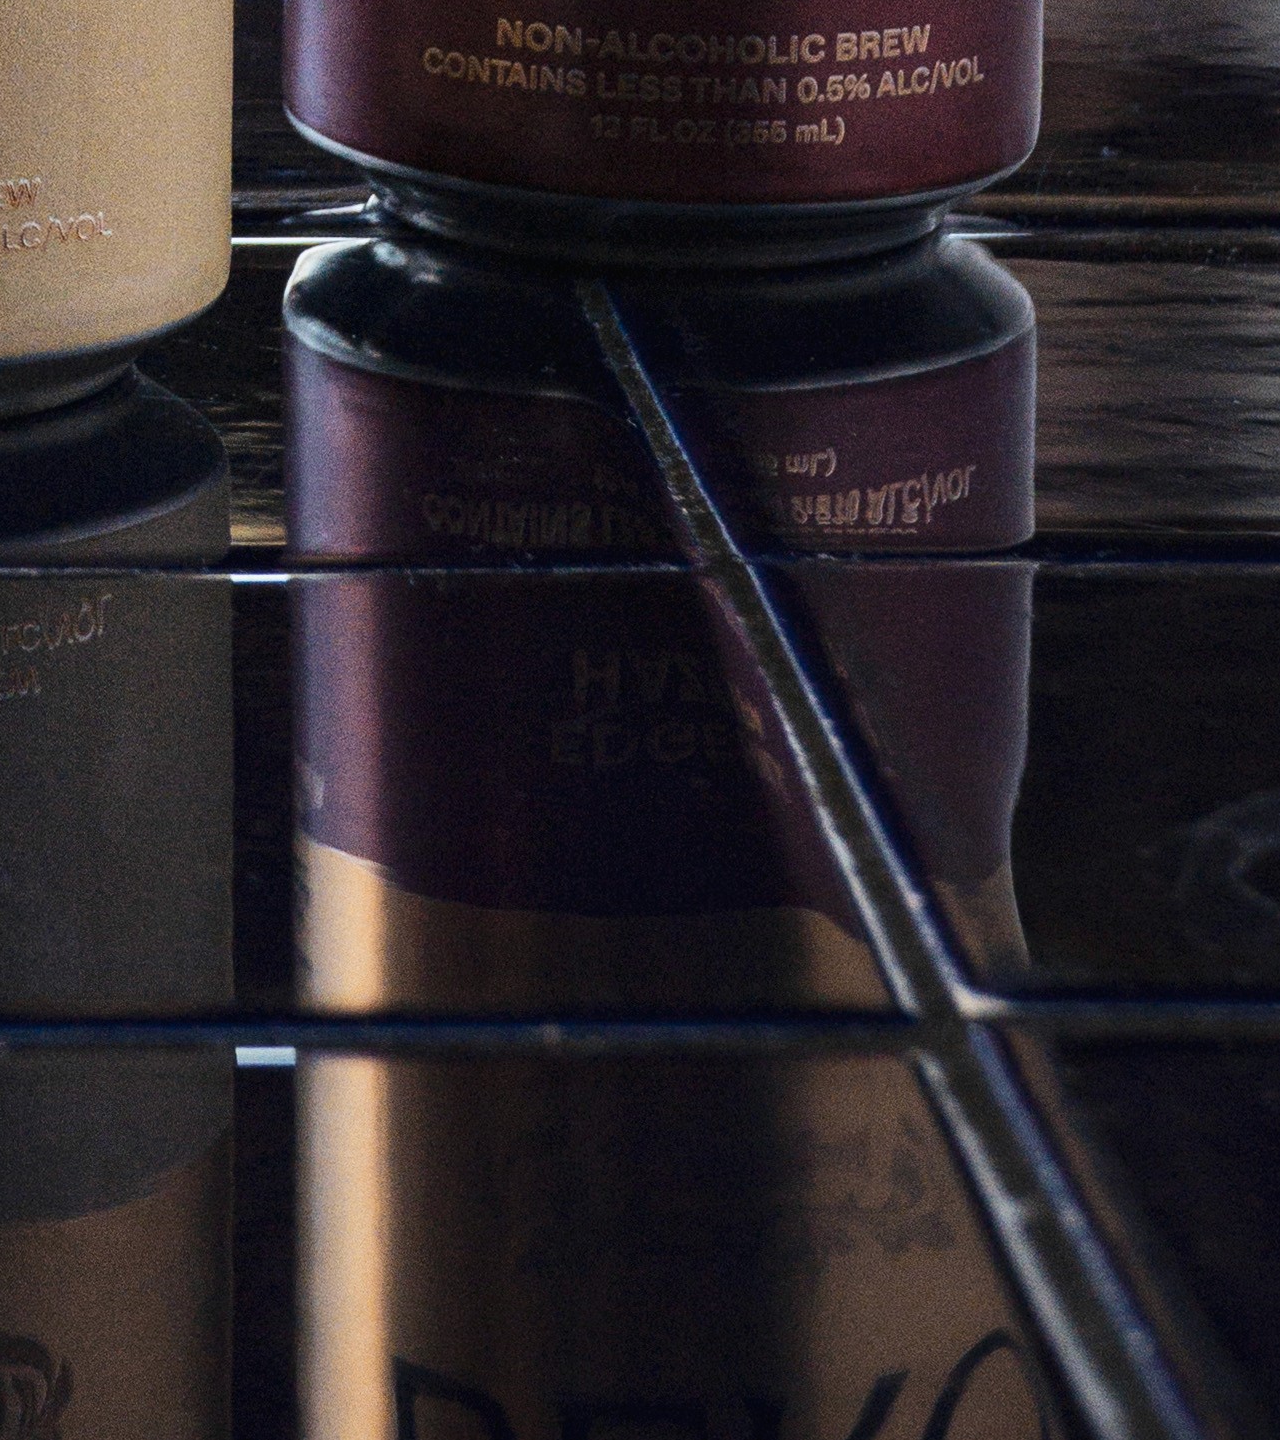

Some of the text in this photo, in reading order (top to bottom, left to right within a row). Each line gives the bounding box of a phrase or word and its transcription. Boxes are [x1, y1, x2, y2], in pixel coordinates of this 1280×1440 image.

[495, 17, 931, 65] NON-ALCOHOLIC BREW
[422, 46, 985, 106] CONTAINS LESS THAN 0.5% ALC/VOL
[795, 115, 846, 147] mL)
